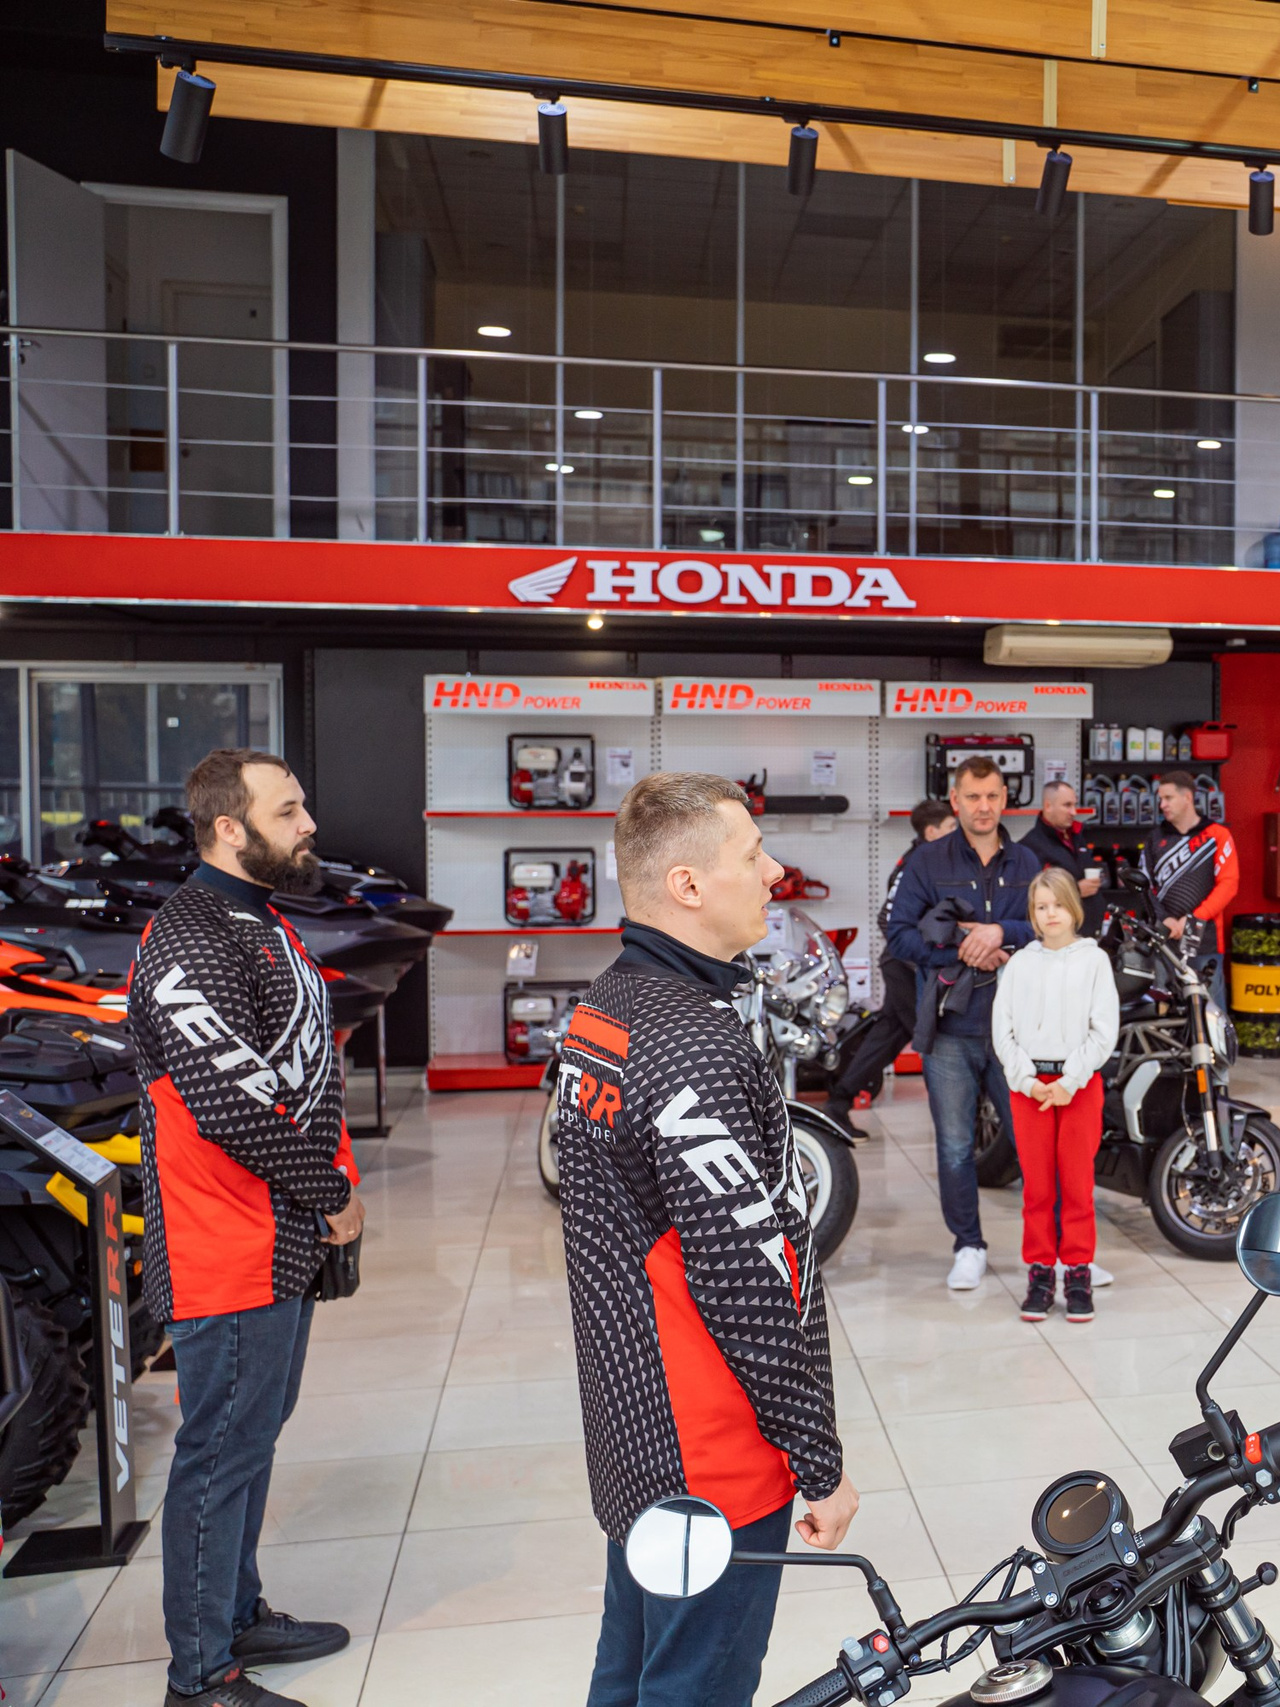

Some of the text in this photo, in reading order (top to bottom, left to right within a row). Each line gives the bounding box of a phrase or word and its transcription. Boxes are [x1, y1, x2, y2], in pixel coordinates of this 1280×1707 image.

[586, 559, 916, 609] HONDA
[433, 681, 581, 710] HND POWER
[588, 681, 648, 691] HONDA
[670, 683, 811, 710] HND POWER
[818, 682, 874, 692] HONDA
[1033, 686, 1087, 695] HONDA
[894, 687, 1028, 713] HND POWER
[104, 1191, 131, 1494] VETERR
